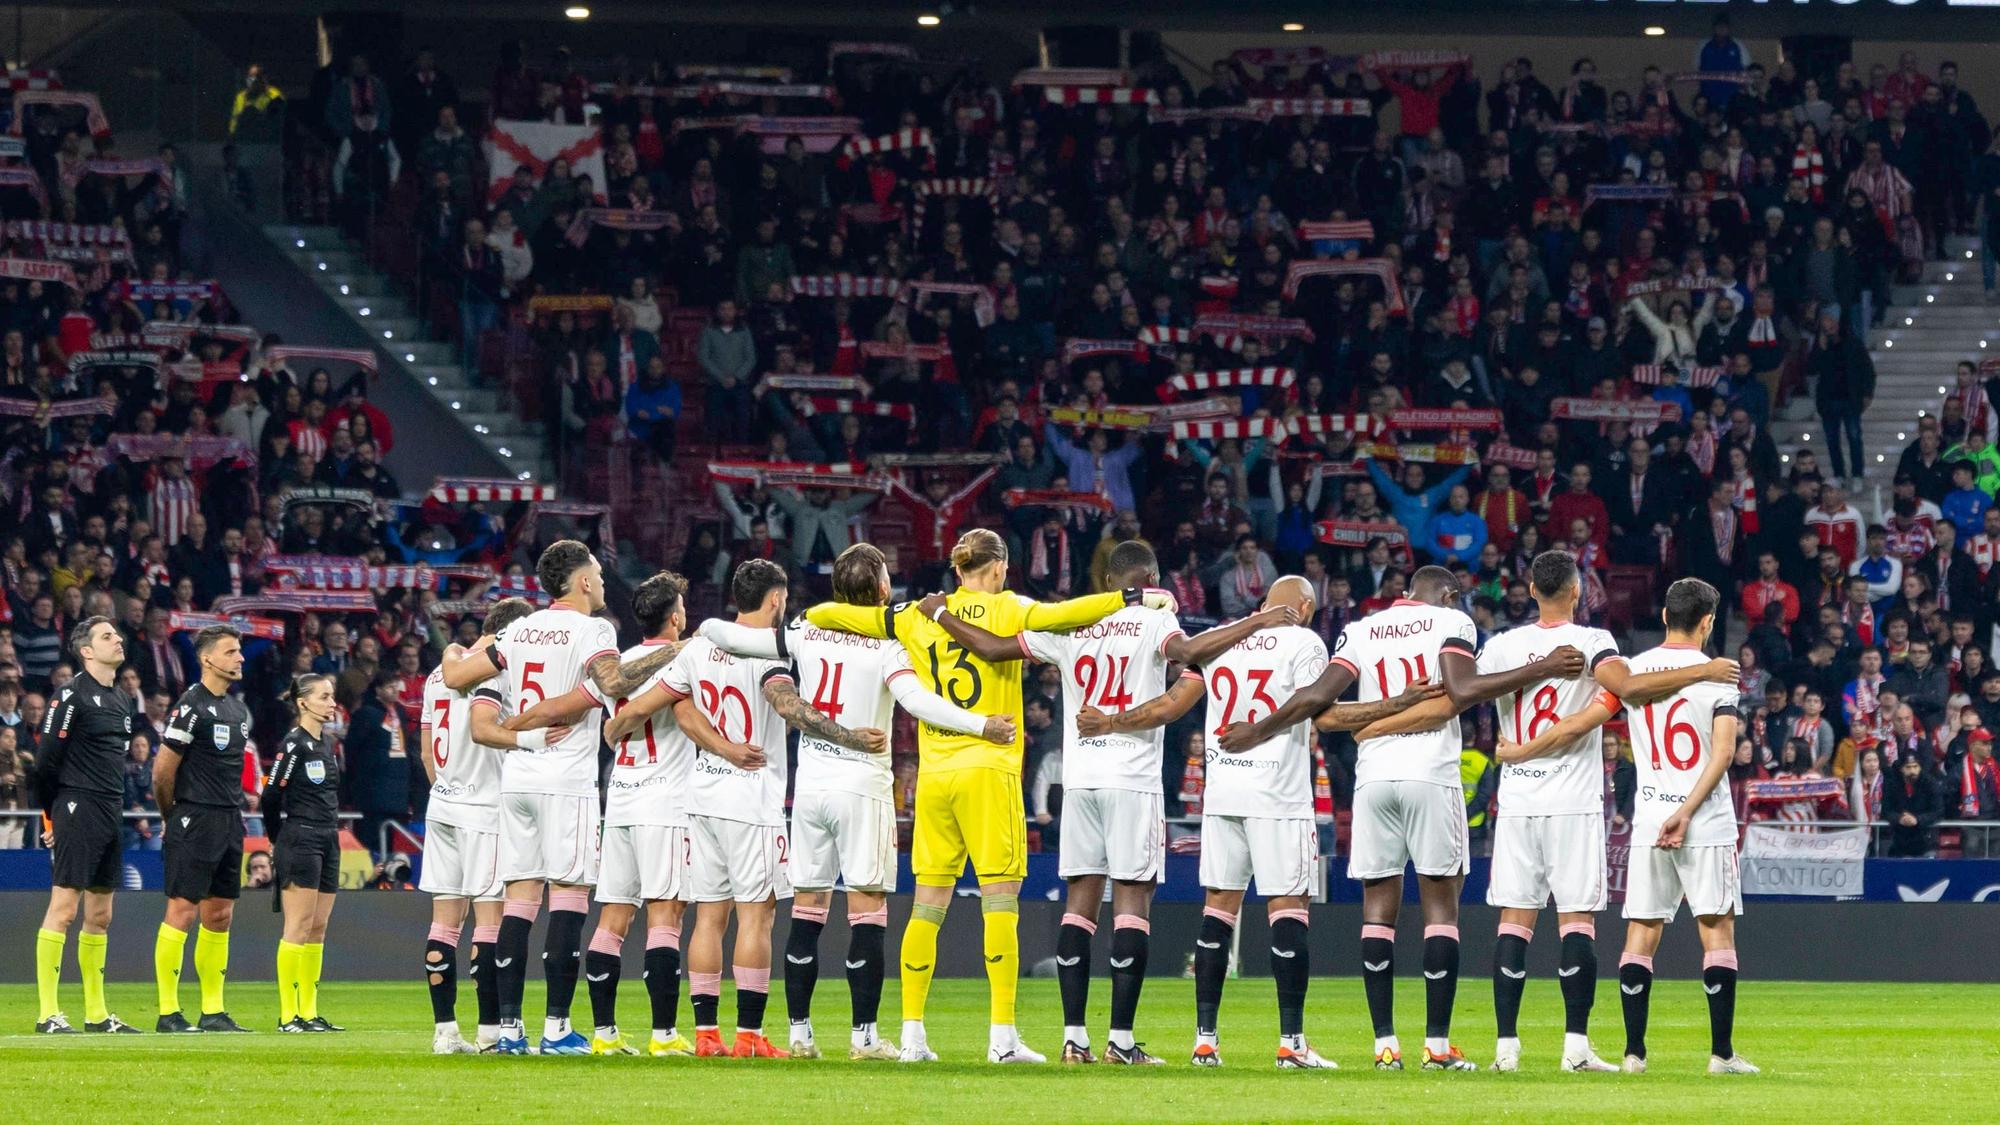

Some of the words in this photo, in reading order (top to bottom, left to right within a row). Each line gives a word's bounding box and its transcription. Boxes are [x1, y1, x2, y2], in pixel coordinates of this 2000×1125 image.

[513, 628, 571, 646] LOCAMPOS
[804, 628, 843, 644] SERGIO
[844, 633, 882, 650] RAMOS
[1369, 618, 1433, 641] NIANZOU
[520, 661, 545, 714] 5
[812, 657, 844, 722] 4
[927, 640, 982, 710] 13
[1074, 653, 1133, 714] 24
[1210, 665, 1279, 736] 23
[433, 699, 451, 769] 3
[1514, 684, 1562, 746] 18
[1643, 697, 1701, 771] 16
[1219, 757, 1280, 770] socios.com
[1756, 832, 1859, 850] HERMOSO
[1757, 866, 1847, 888] CONTIGO
